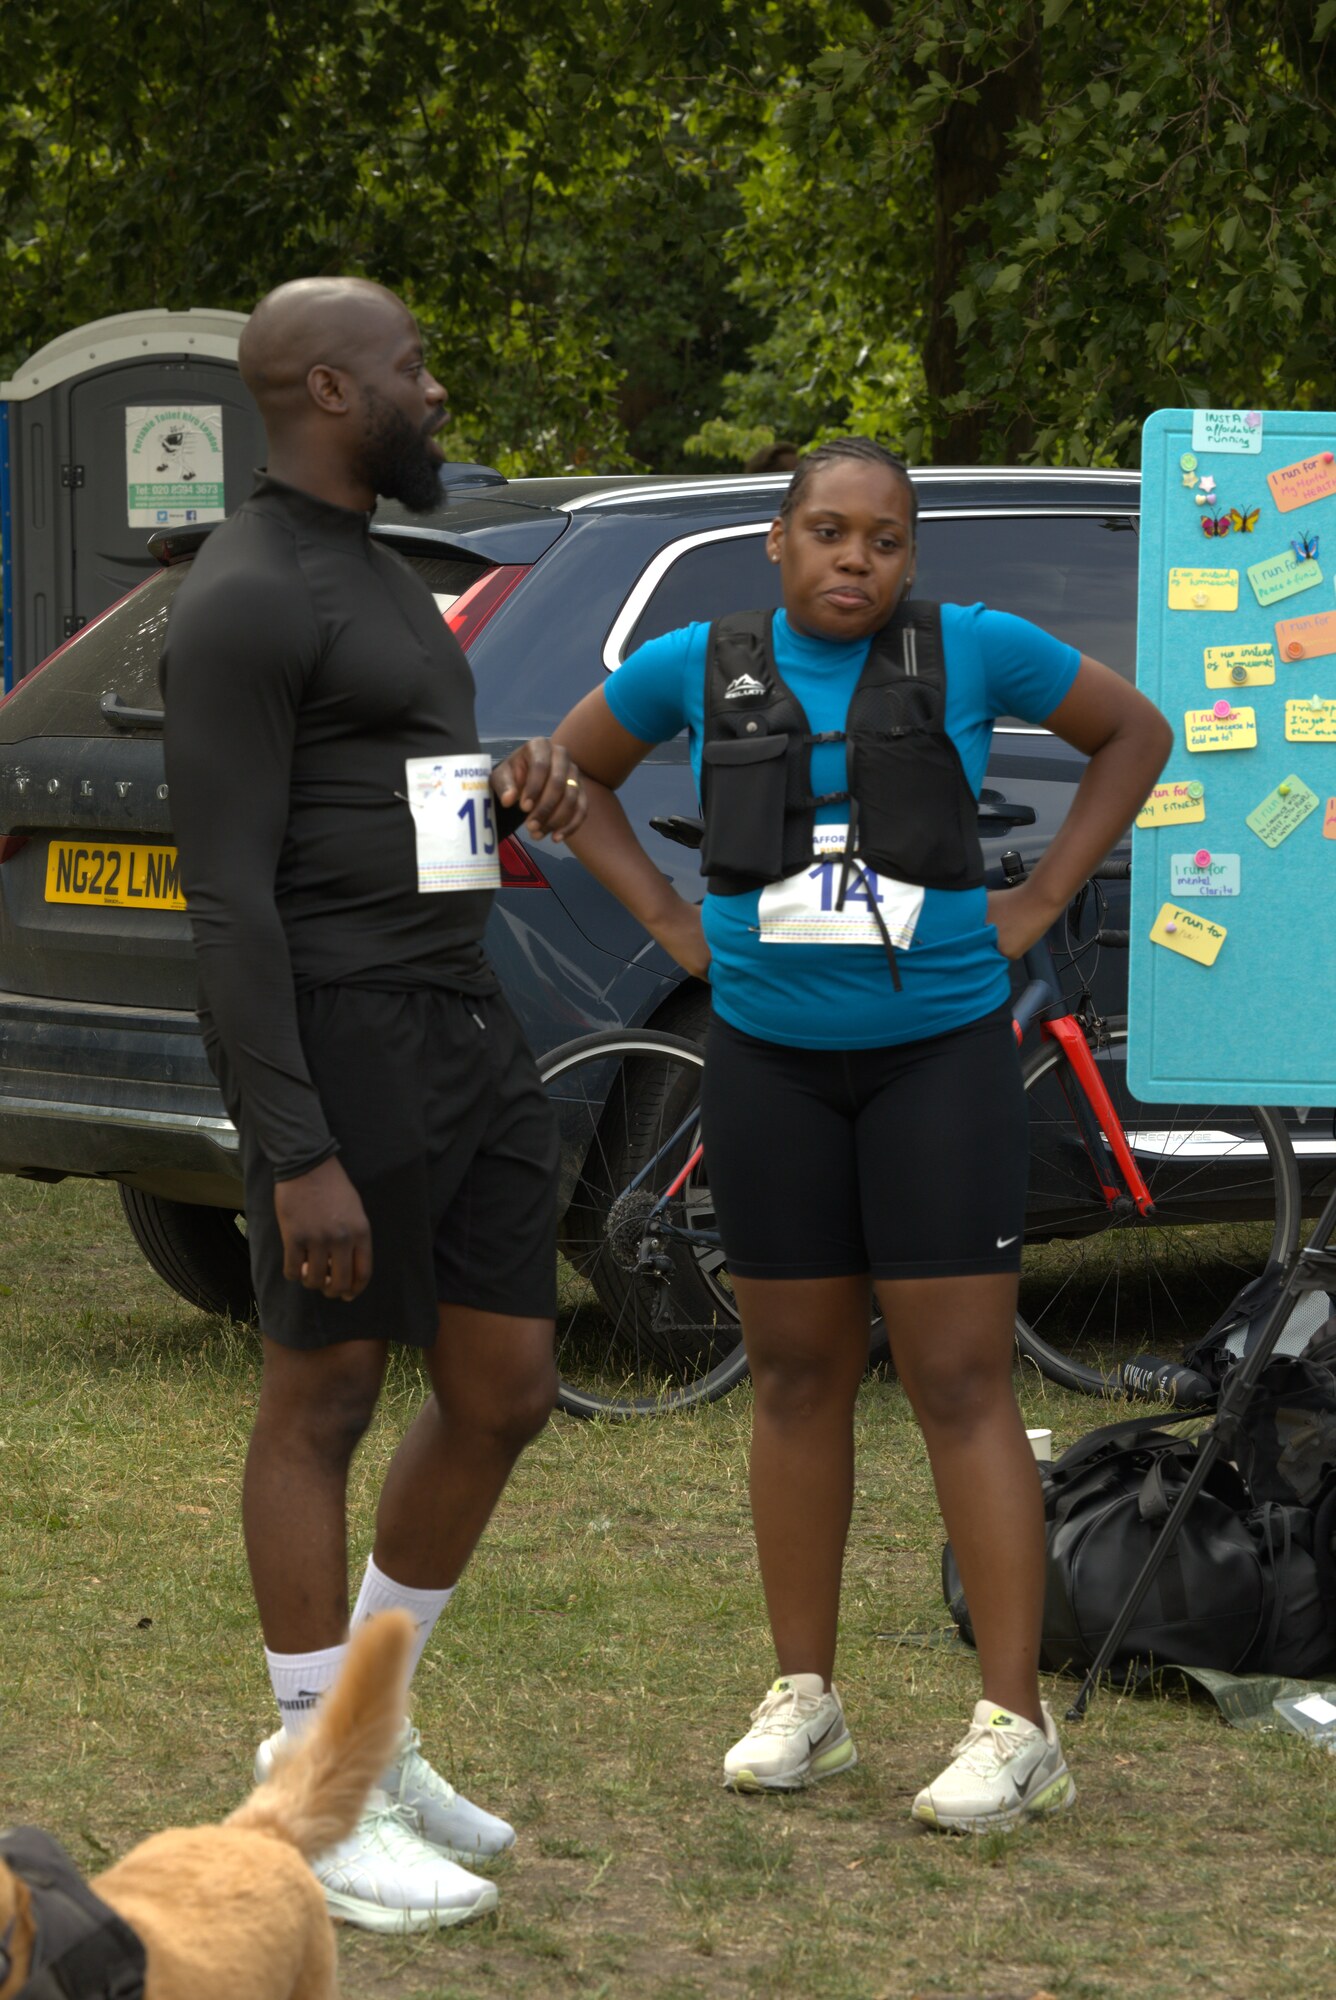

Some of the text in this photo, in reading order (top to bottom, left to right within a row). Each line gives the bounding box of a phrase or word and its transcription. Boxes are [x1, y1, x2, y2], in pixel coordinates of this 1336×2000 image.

[1205, 413, 1242, 423] INSTA
[154, 411, 181, 424] Toilet
[199, 422, 219, 454] London
[1208, 435, 1250, 448] running
[1272, 460, 1319, 485] I run for
[1262, 566, 1284, 580] run
[1290, 620, 1313, 631] run
[1314, 614, 1331, 626] for
[16, 778, 169, 800] VOLVO
[457, 798, 495, 856] 15
[56, 848, 180, 900] NG22 LNM
[1175, 864, 1179, 875] I
[1208, 862, 1228, 876] for
[809, 862, 884, 912] 14
[1177, 876, 1211, 885] mental
[1182, 916, 1204, 931] run
[1207, 925, 1222, 938] for
[1138, 1133, 1212, 1142] RECHARGE
